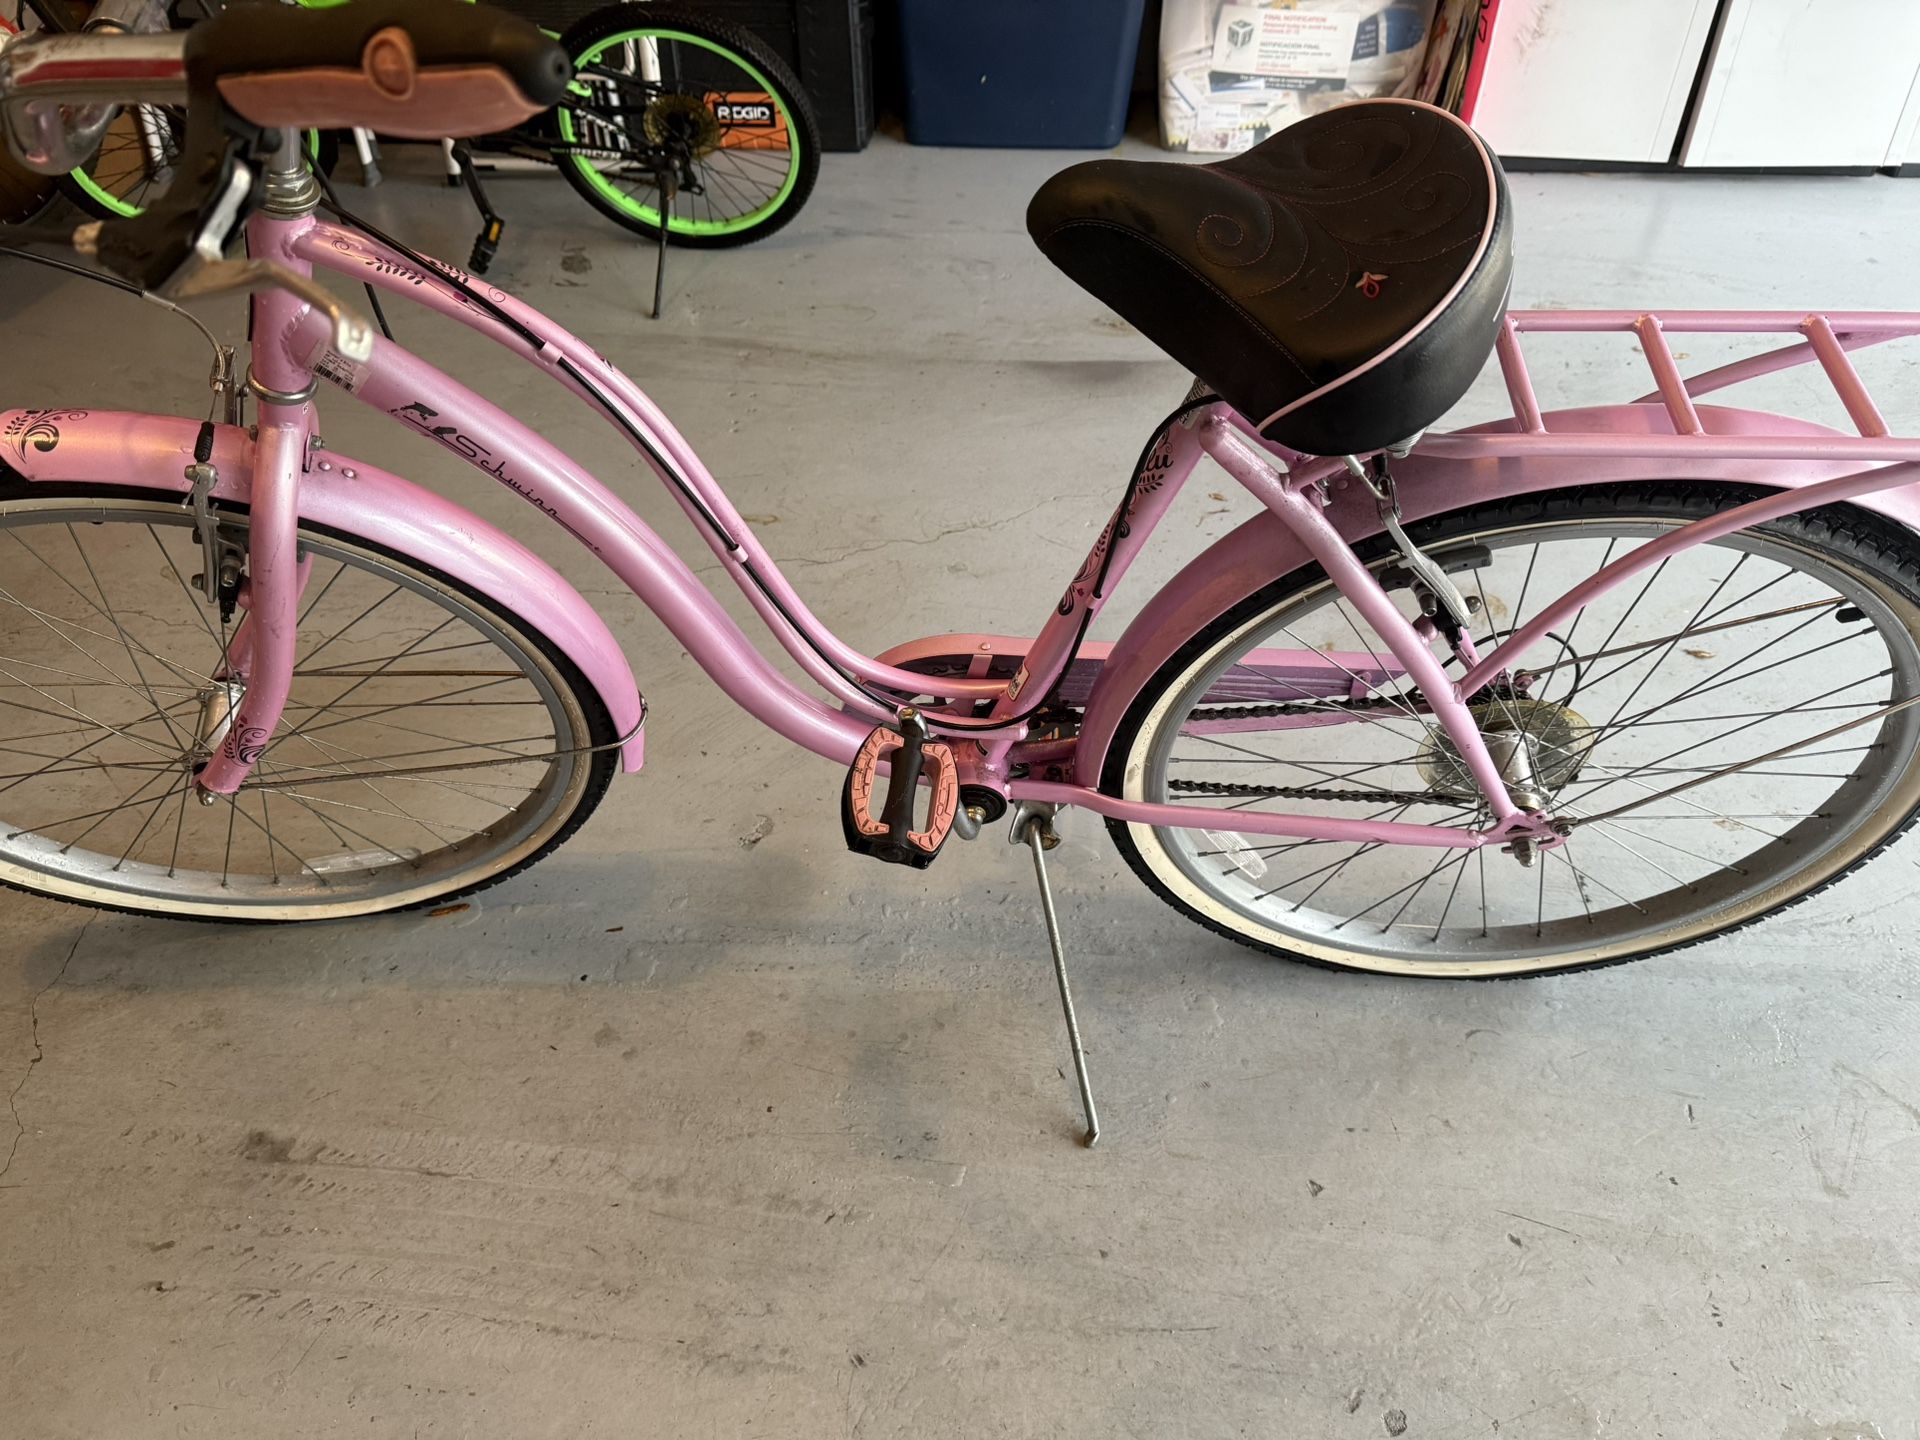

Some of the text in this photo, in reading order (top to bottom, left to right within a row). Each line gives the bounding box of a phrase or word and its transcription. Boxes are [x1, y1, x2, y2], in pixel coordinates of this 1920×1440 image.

[1283, 14, 1327, 22] NOTIFICATION
[717, 105, 770, 120] RDGID
[455, 434, 566, 521] Schwinn
